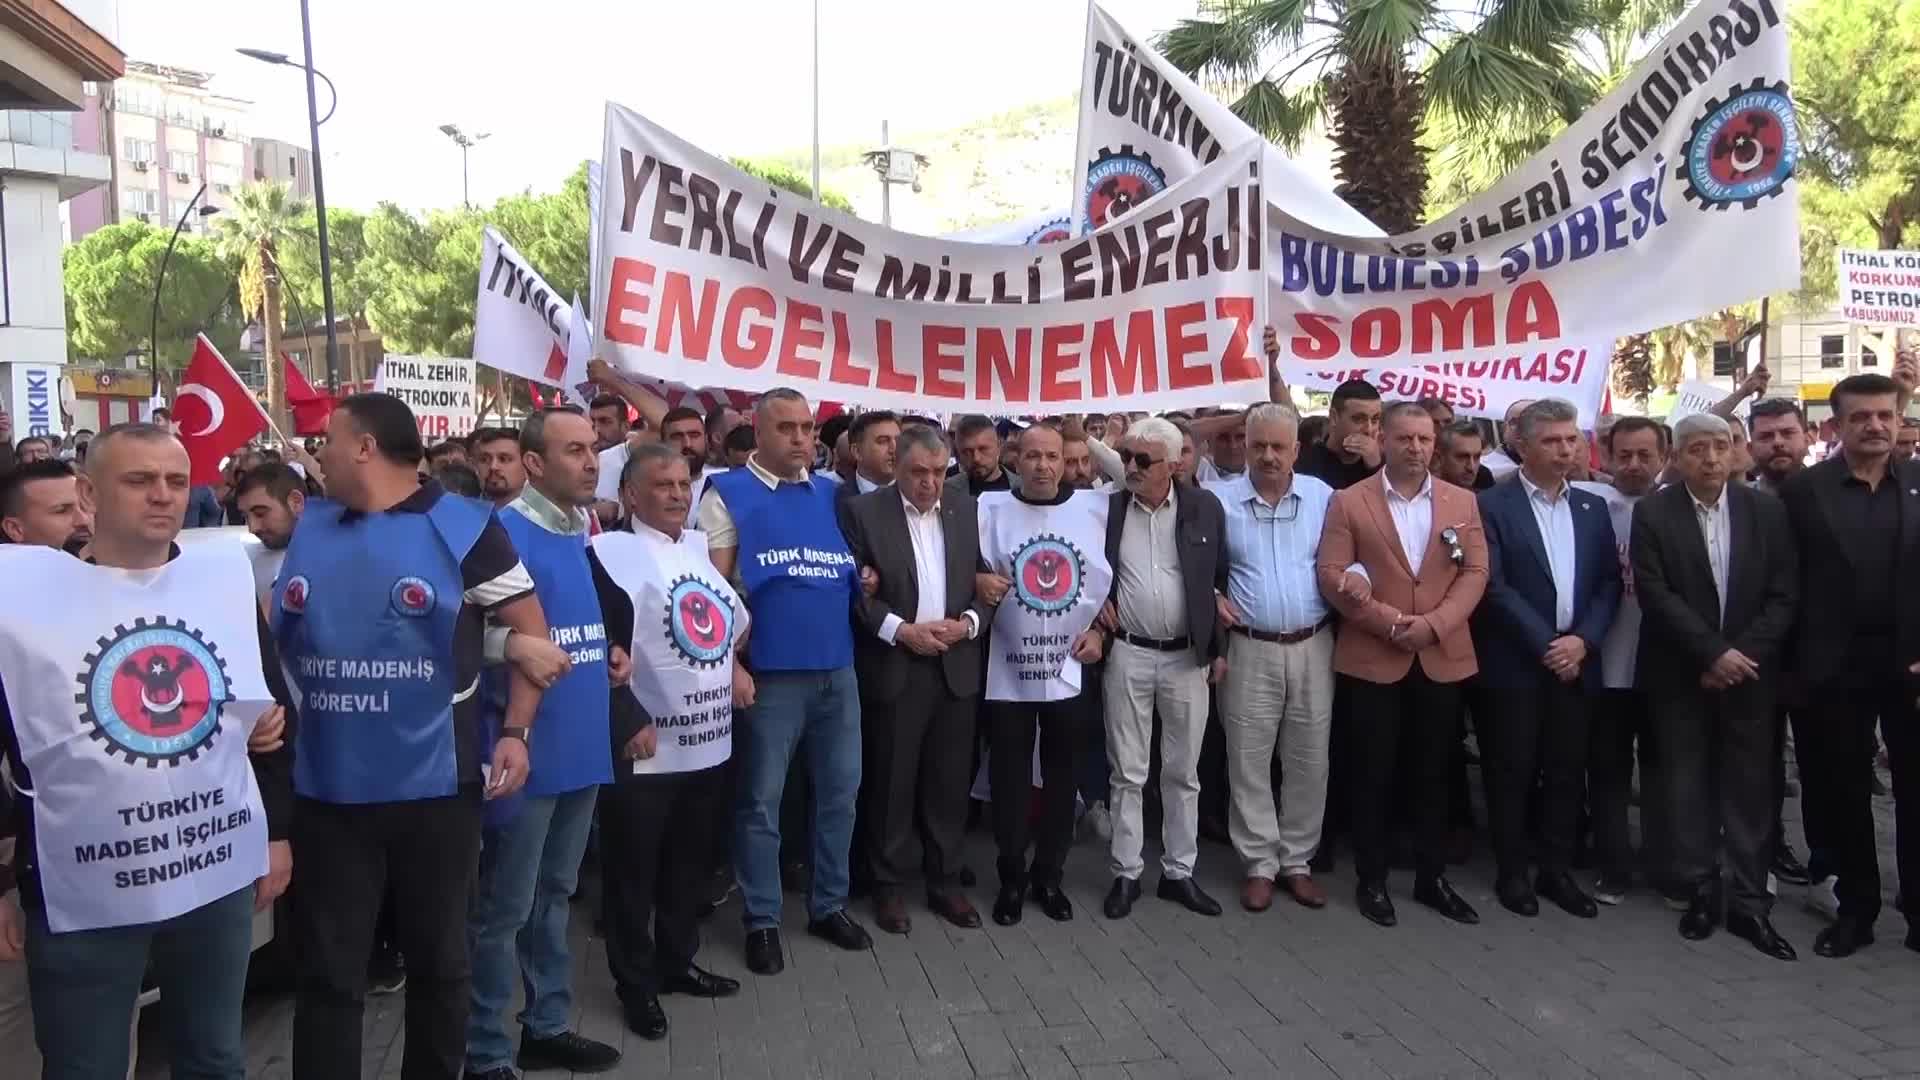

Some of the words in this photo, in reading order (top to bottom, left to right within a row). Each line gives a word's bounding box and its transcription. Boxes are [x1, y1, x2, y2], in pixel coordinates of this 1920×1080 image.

[1580, 0, 1780, 190] SENDİKASI
[618, 146, 776, 271] YERLİ
[789, 212, 867, 292] VE
[874, 254, 1043, 304] MİLLİ
[1059, 161, 1262, 302] ENERJİ
[1500, 152, 1669, 285] ŞUBESİ
[603, 257, 1263, 403] ENGELLENEMEZ
[1290, 279, 1562, 361] SOMA
[385, 357, 424, 381] İTHAL
[756, 547, 801, 567] TÜRK
[549, 626, 582, 646] ÜRK
[341, 656, 435, 682] MADEN-İŞ
[1006, 650, 1044, 665] MADEN
[310, 690, 391, 713] GÖREVLİ
[655, 711, 709, 729] MADEN
[117, 787, 225, 827] TÜRKİYE
[74, 832, 170, 864] MADEN
[176, 803, 252, 848] İŞÇİLERİ
[114, 842, 233, 889] SENDİKASI
